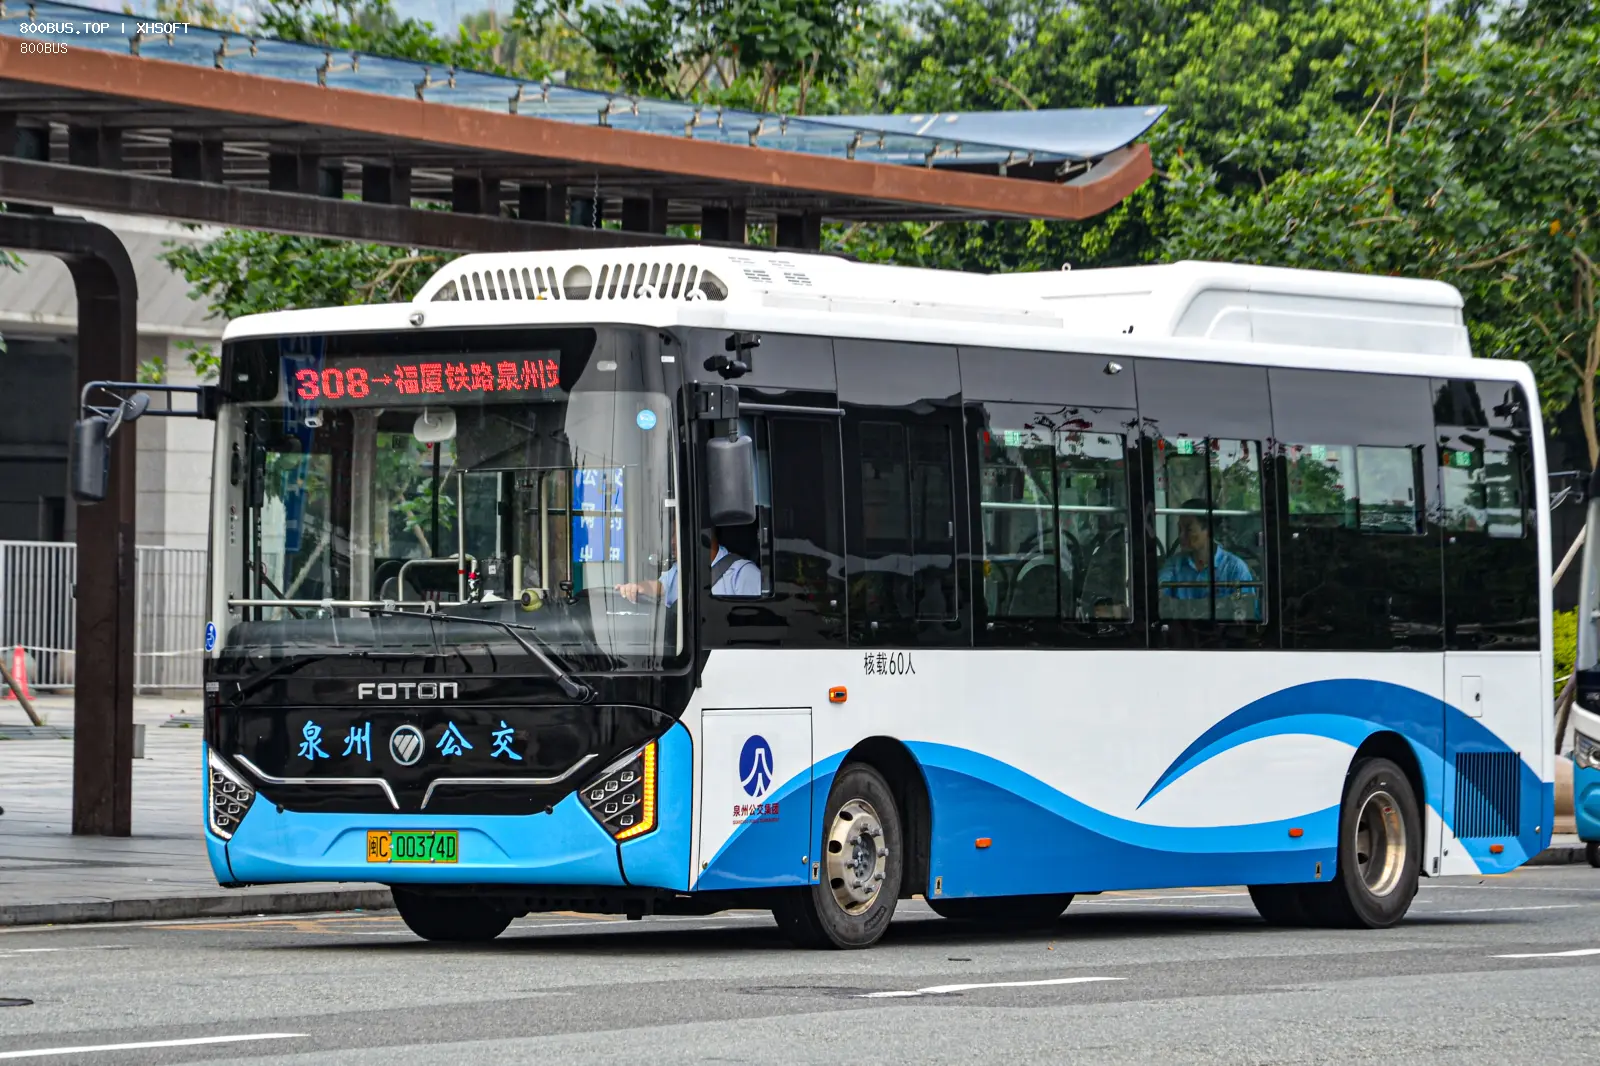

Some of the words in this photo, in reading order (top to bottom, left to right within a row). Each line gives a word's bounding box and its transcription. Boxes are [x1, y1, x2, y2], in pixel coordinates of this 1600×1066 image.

[295, 368, 368, 399] 308
[864, 652, 915, 675] 核载60人
[358, 682, 458, 699] FOTON
